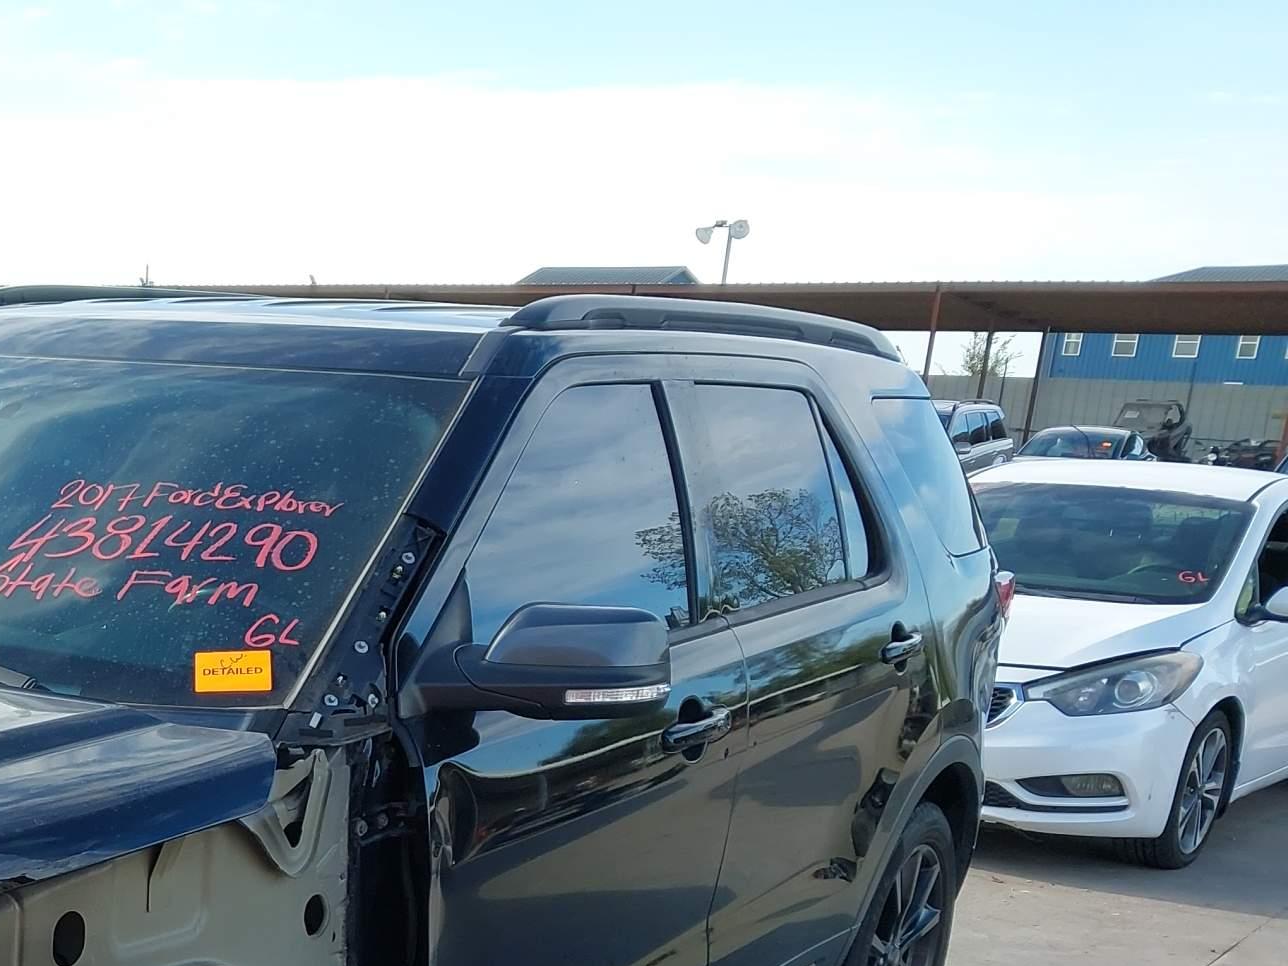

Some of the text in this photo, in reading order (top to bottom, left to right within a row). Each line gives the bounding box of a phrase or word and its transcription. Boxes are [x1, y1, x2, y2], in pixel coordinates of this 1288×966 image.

[51, 479, 142, 512] 2017
[7, 513, 318, 571] 43814290
[117, 569, 259, 608] Farm
[202, 666, 264, 676] DETAILED
